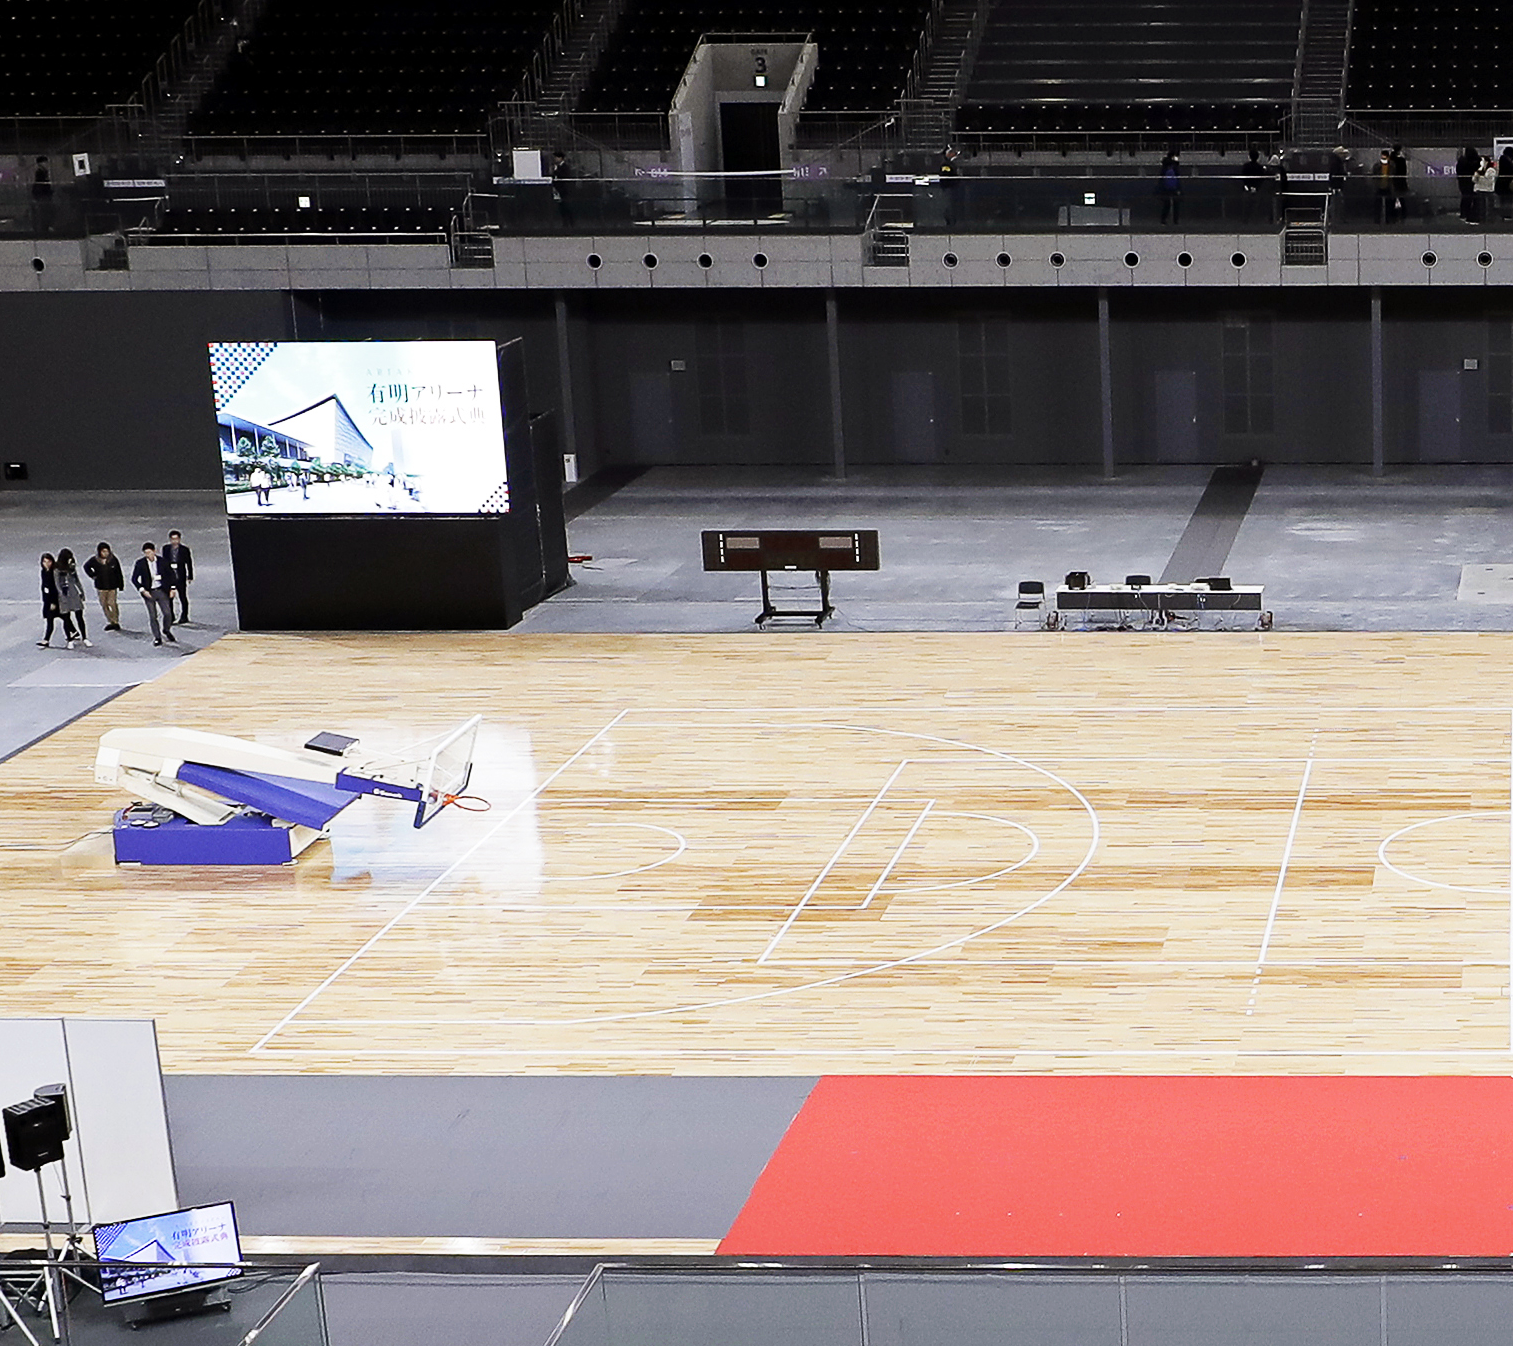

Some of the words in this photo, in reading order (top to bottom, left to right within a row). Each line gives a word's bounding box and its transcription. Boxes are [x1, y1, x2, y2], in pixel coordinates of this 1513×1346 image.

[755, 57, 767, 74] 3
[367, 383, 484, 404] 有明アリーナ
